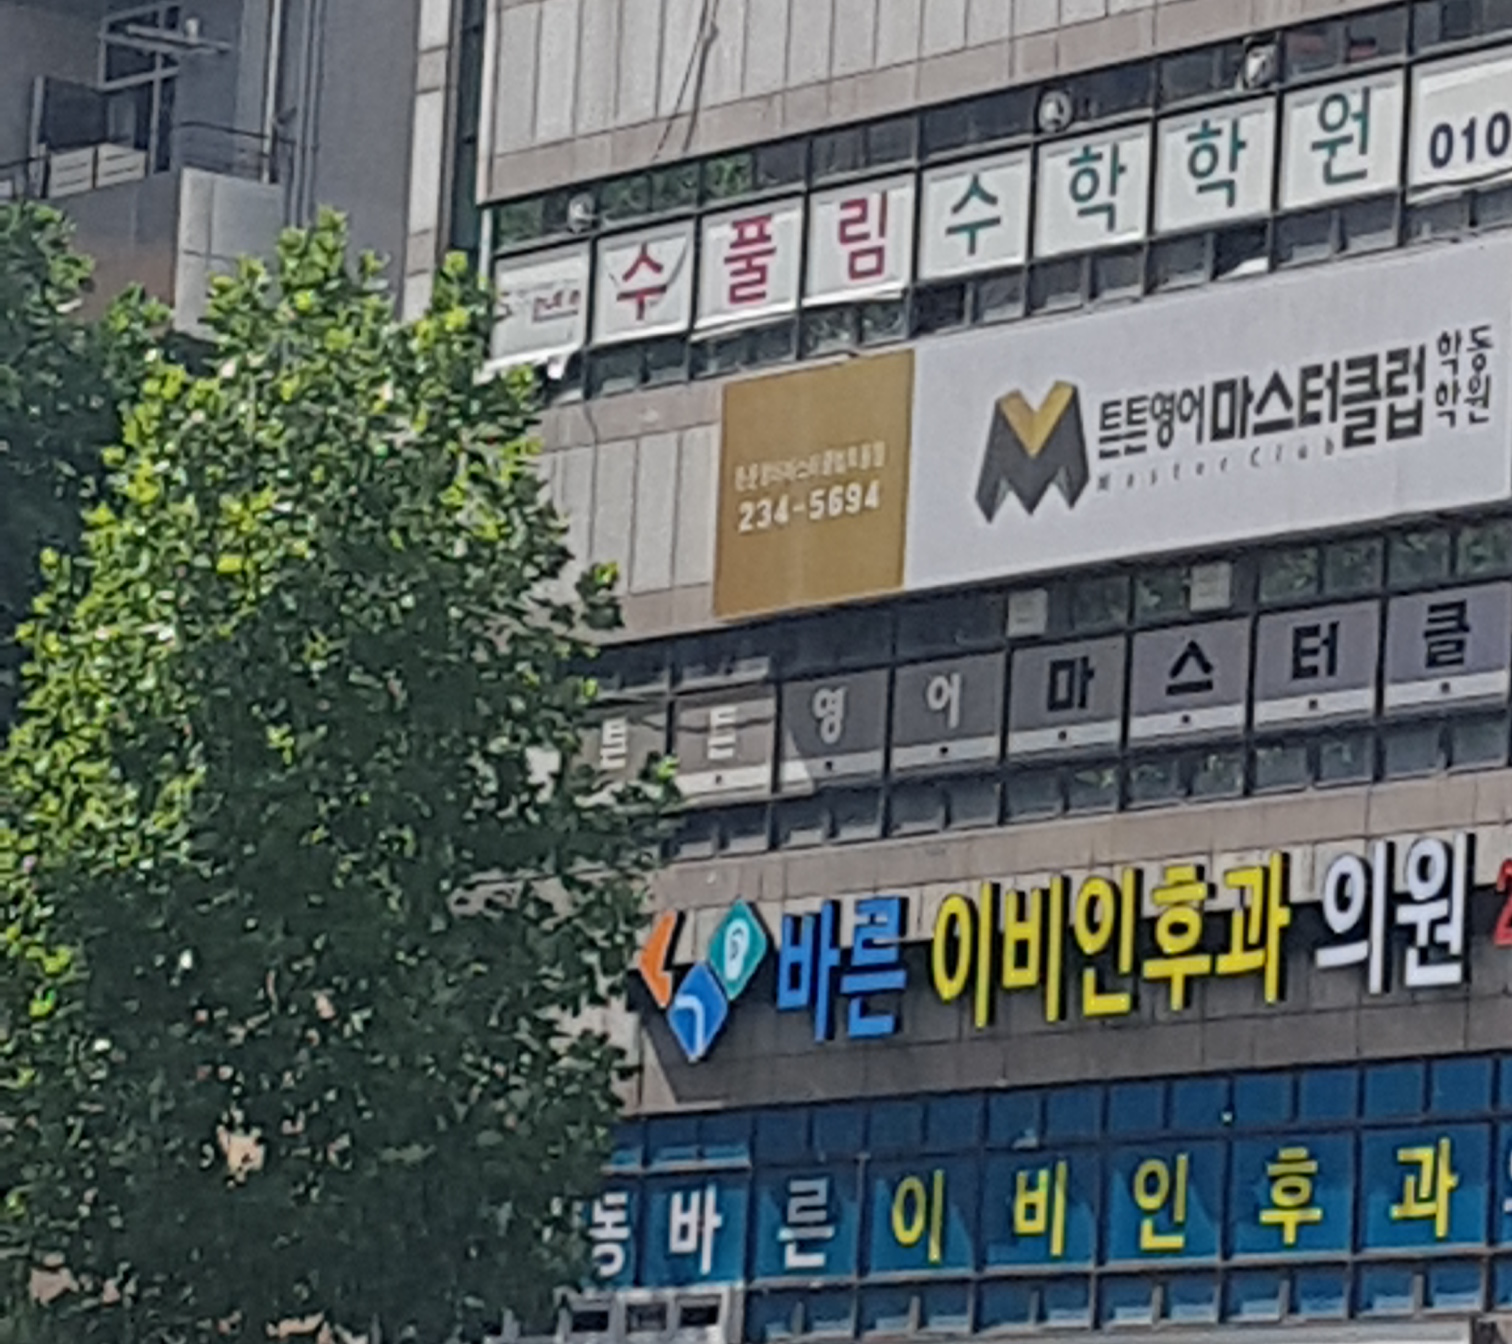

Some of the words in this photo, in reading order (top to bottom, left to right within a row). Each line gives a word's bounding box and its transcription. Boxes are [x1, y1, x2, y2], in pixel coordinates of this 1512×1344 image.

[1430, 111, 1512, 170] 010
[615, 189, 889, 322] 수풀림
[1098, 385, 1206, 460] 튼튼영어
[1208, 342, 1428, 450] 마스터클럽
[738, 478, 881, 533] 234-5694
[776, 895, 908, 1044] 바른
[931, 851, 1292, 1030] 이비인후과
[1315, 831, 1470, 996] 의원
